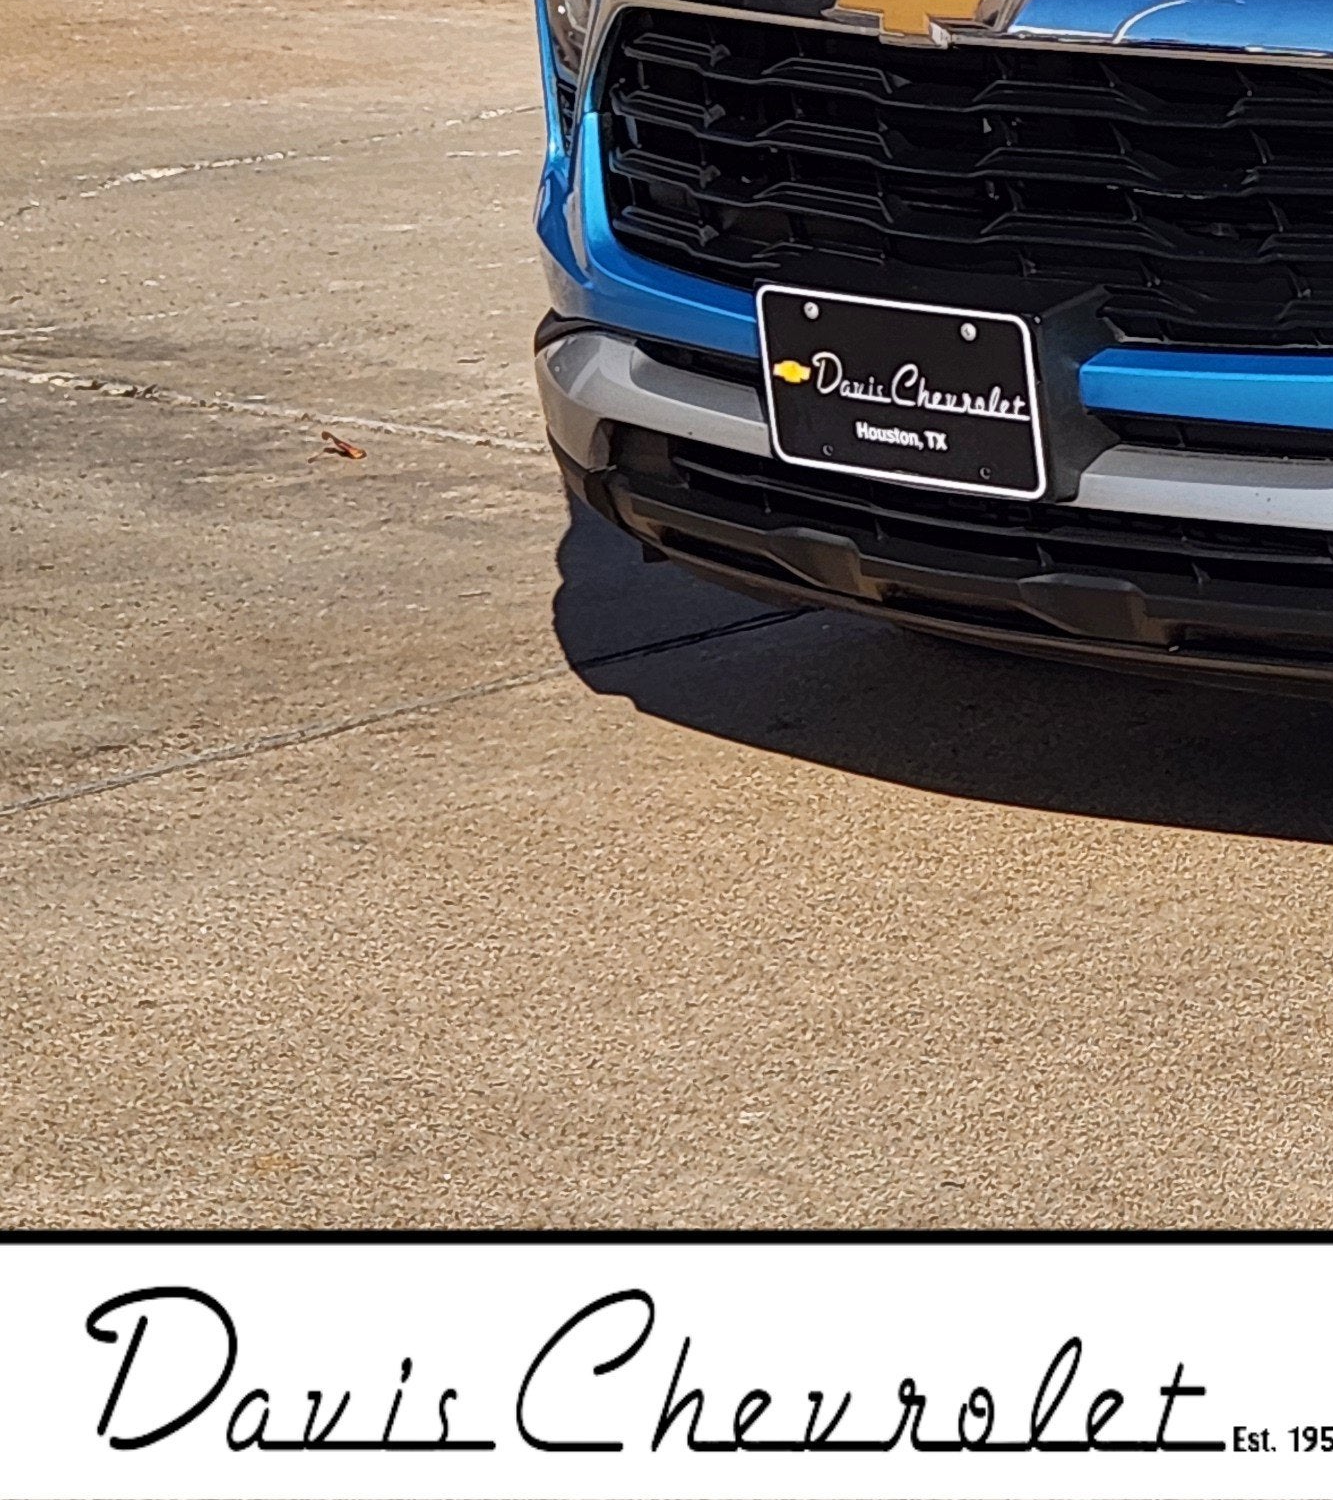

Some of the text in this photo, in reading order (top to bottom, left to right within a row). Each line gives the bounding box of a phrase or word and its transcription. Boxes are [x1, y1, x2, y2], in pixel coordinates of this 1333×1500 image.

[812, 351, 1031, 422] Davis Chevrolet
[856, 421, 948, 451] Houston, TX
